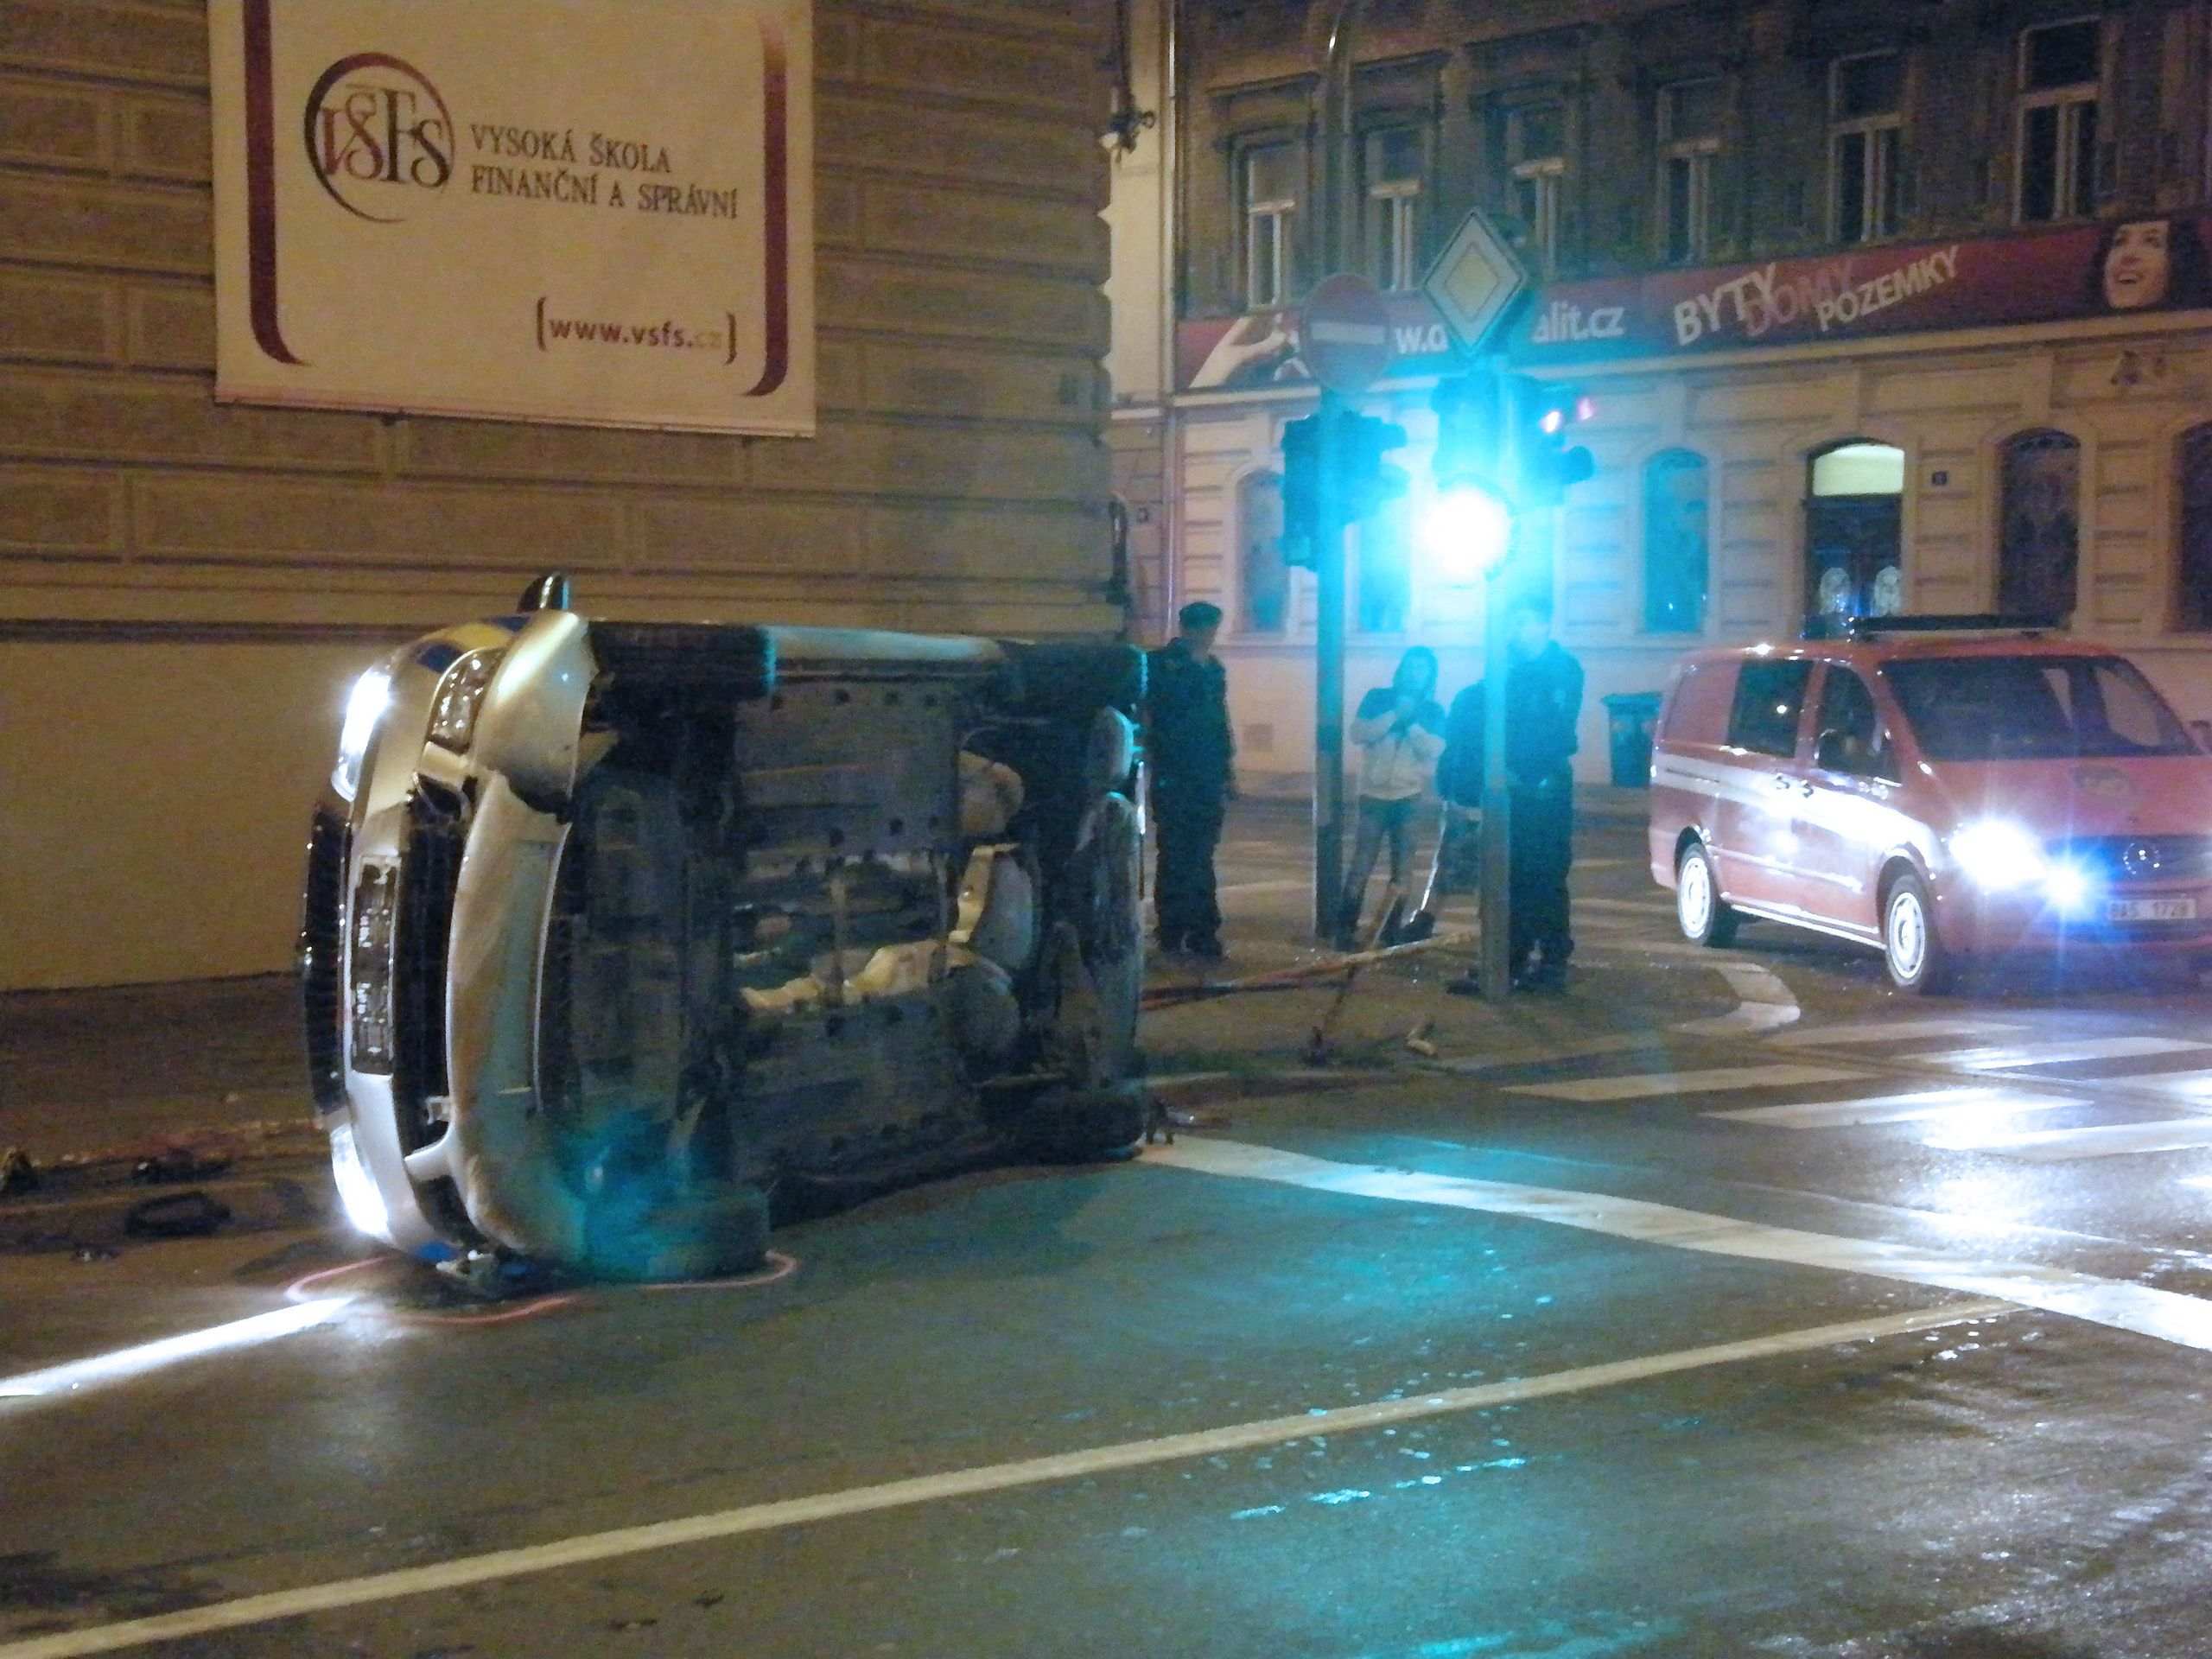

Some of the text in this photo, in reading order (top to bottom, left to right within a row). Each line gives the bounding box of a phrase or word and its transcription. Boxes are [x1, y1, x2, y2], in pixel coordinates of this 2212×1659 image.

[470, 124, 672, 174] VYSOKÁ ŠKOLA
[471, 163, 738, 220] FINANČNÍ A SPRÁVNÍ
[1673, 261, 1777, 346] BYTY
[1814, 245, 1959, 332] POZEMKY
